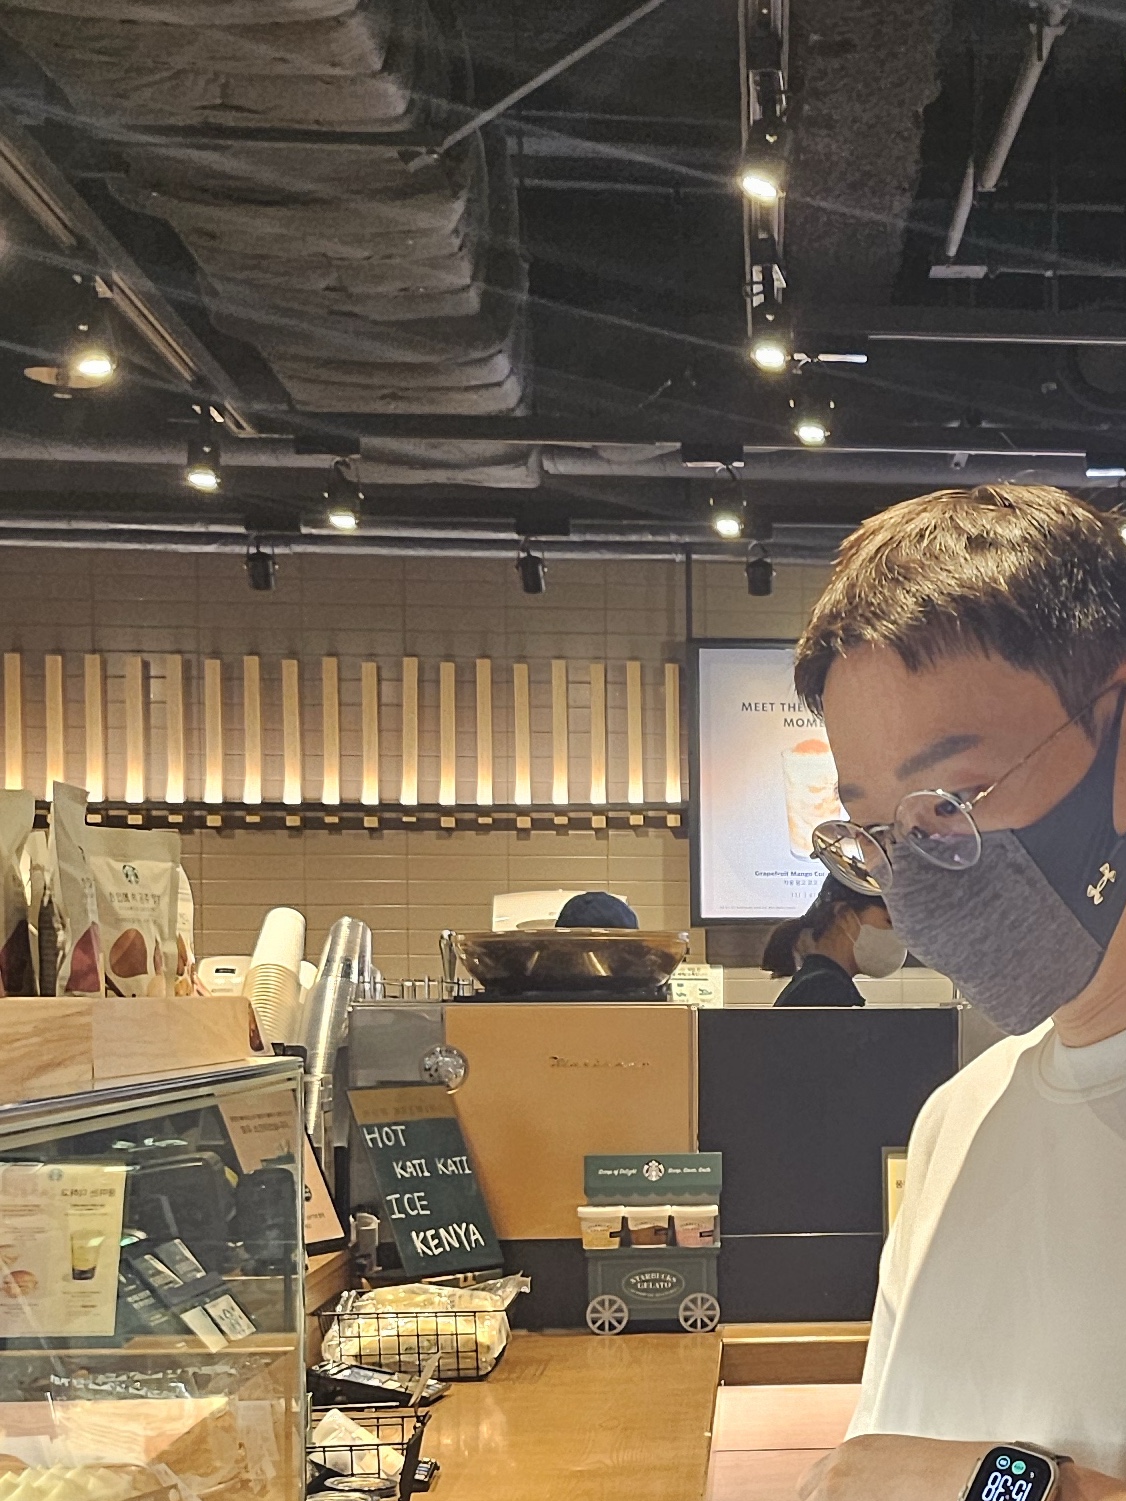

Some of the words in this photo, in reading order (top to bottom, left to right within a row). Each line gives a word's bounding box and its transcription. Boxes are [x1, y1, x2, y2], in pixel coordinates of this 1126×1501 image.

[741, 702, 775, 712] MEET
[780, 702, 803, 712] THE
[363, 1125, 406, 1148] HOT
[392, 1158, 431, 1179] KATI
[435, 1156, 472, 1175] KATI
[386, 1192, 431, 1219] ICE
[411, 1222, 485, 1257] KENYA
[630, 1272, 677, 1285] STARBUCKS
[637, 1281, 672, 1289] GELATO
